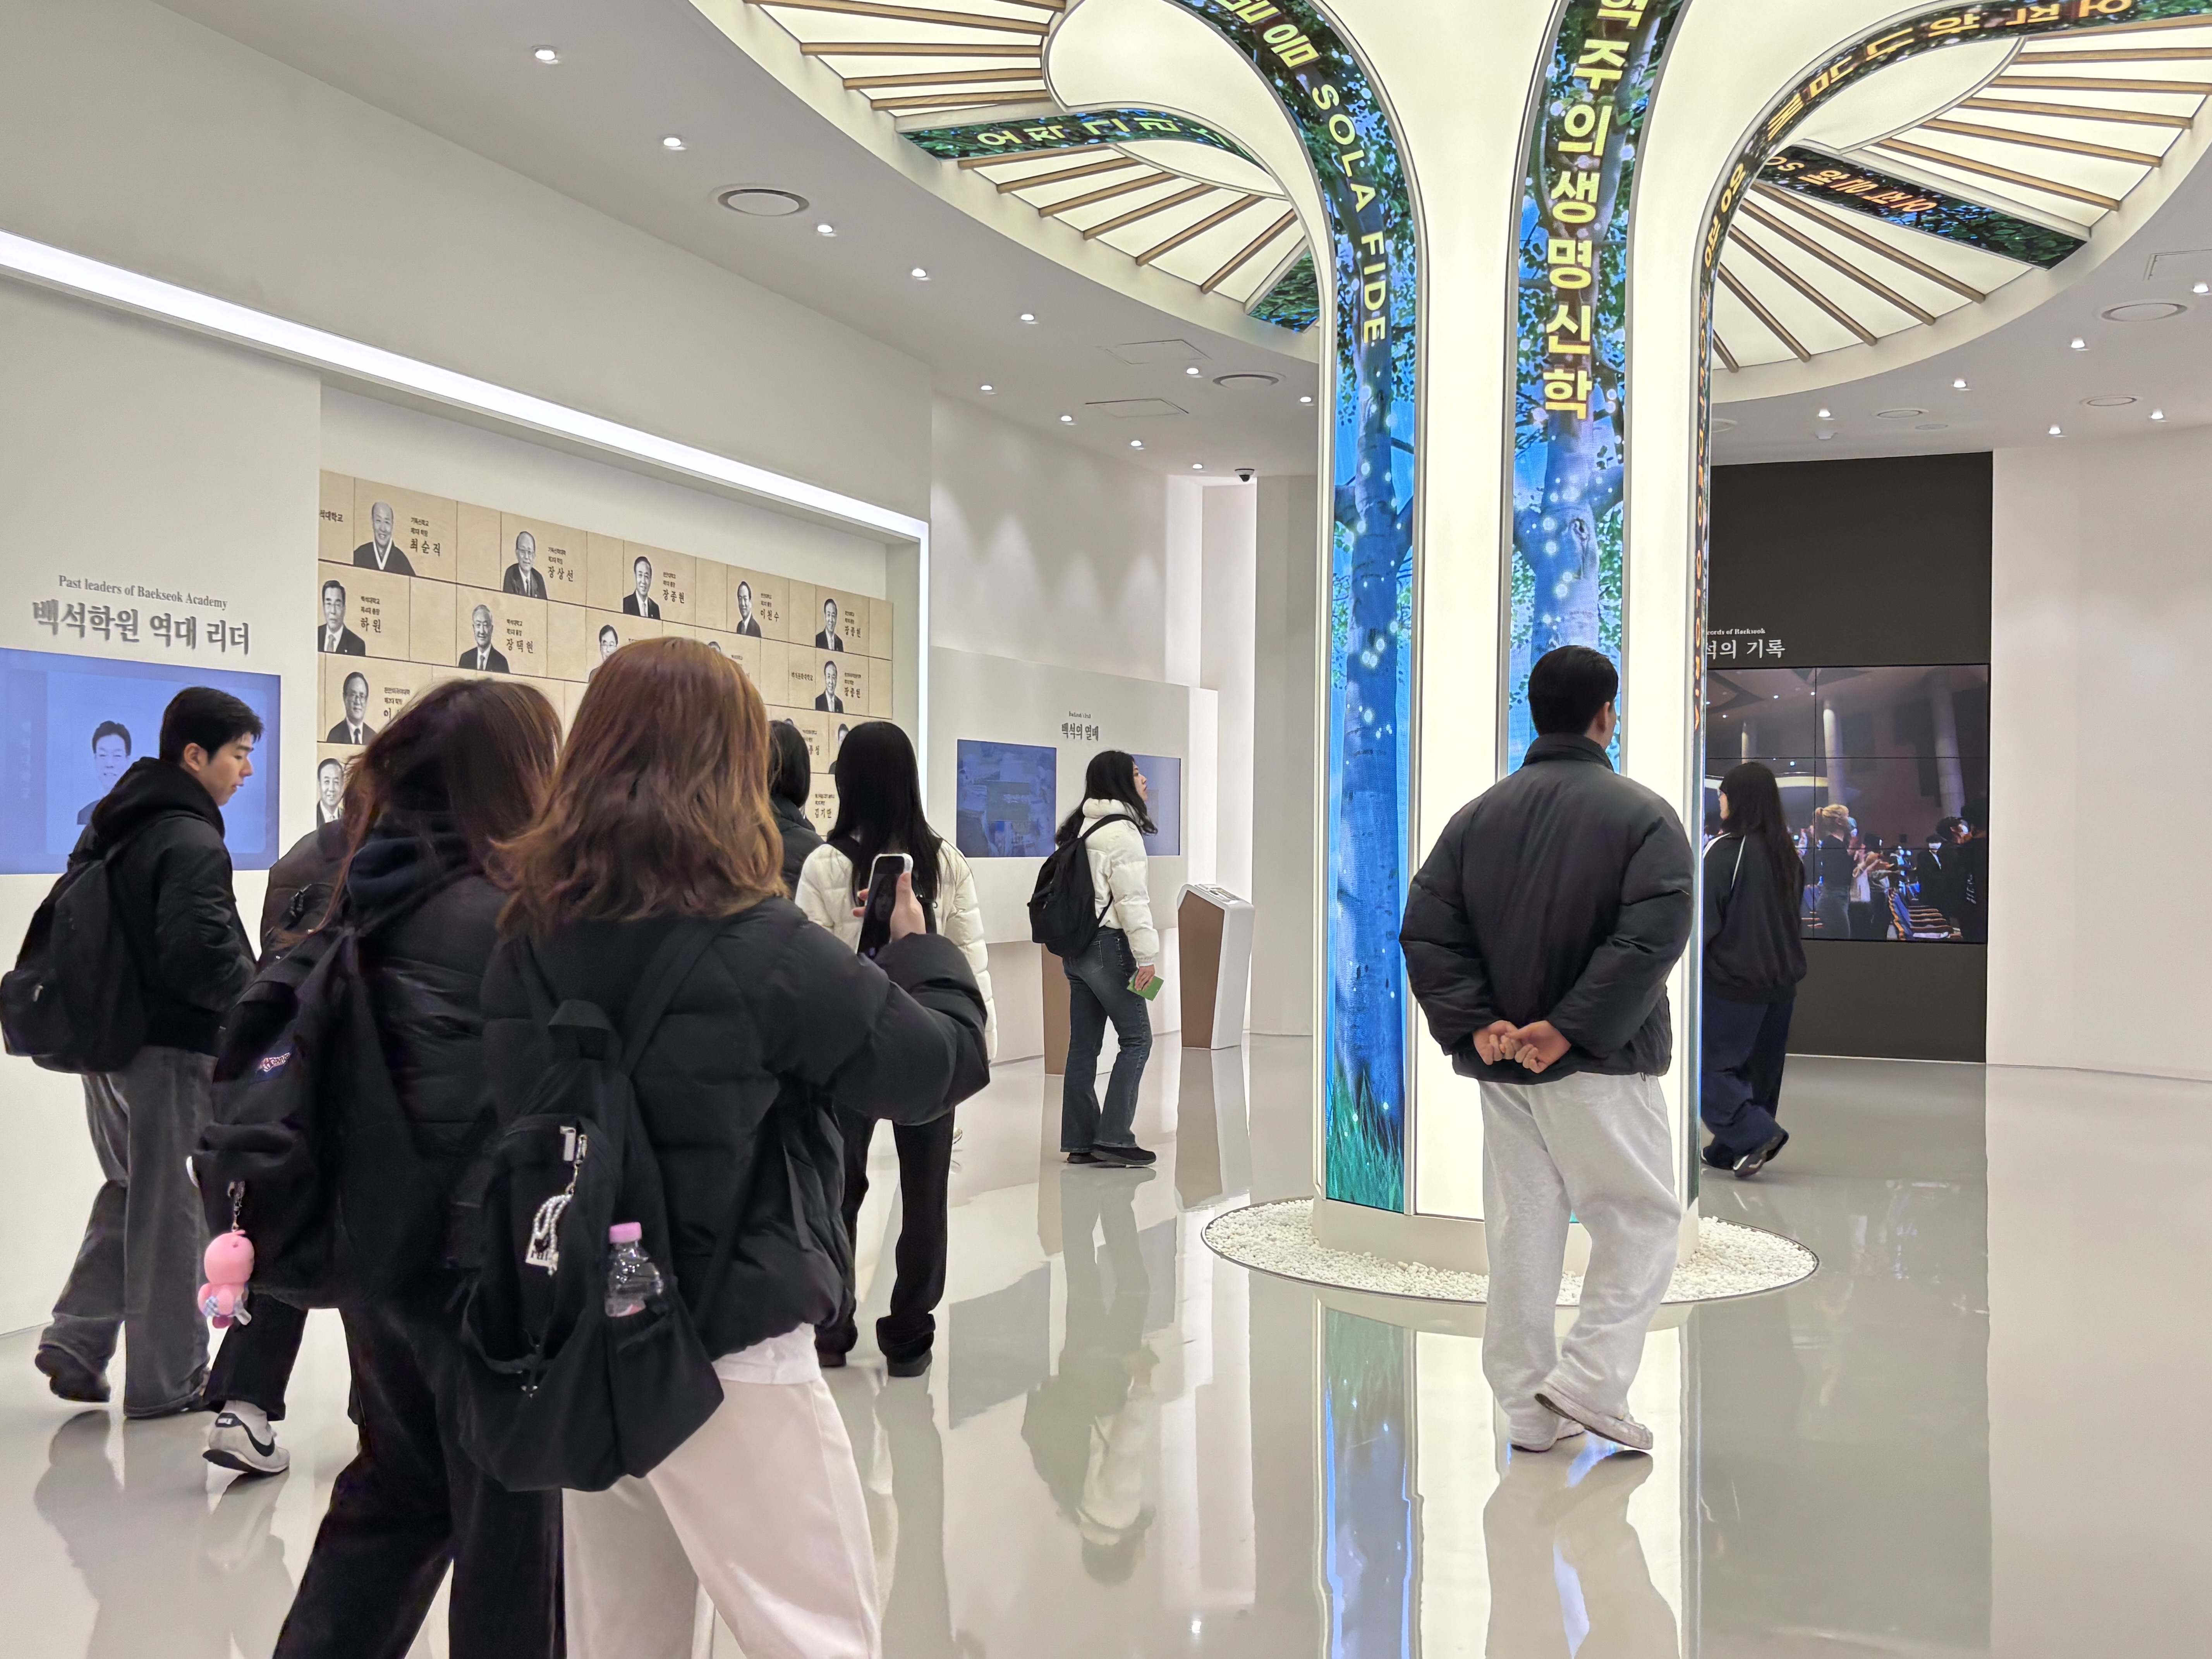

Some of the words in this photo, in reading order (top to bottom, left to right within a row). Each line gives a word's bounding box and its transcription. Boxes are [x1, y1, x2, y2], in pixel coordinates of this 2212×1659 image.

[978, 125, 1066, 146] 오직
[1083, 117, 1253, 160] 그리스
[1312, 84, 1376, 213] SOLA
[1361, 231, 1386, 343] FIDE
[59, 575, 81, 589] Past
[84, 578, 122, 594] leaders
[125, 585, 136, 596] of
[137, 586, 183, 603] Baekseok
[185, 592, 228, 611] Academy
[32, 599, 140, 643] 백석학원
[150, 613, 197, 651] 역대
[206, 620, 249, 656] 리더
[1747, 639, 1786, 659] 기록
